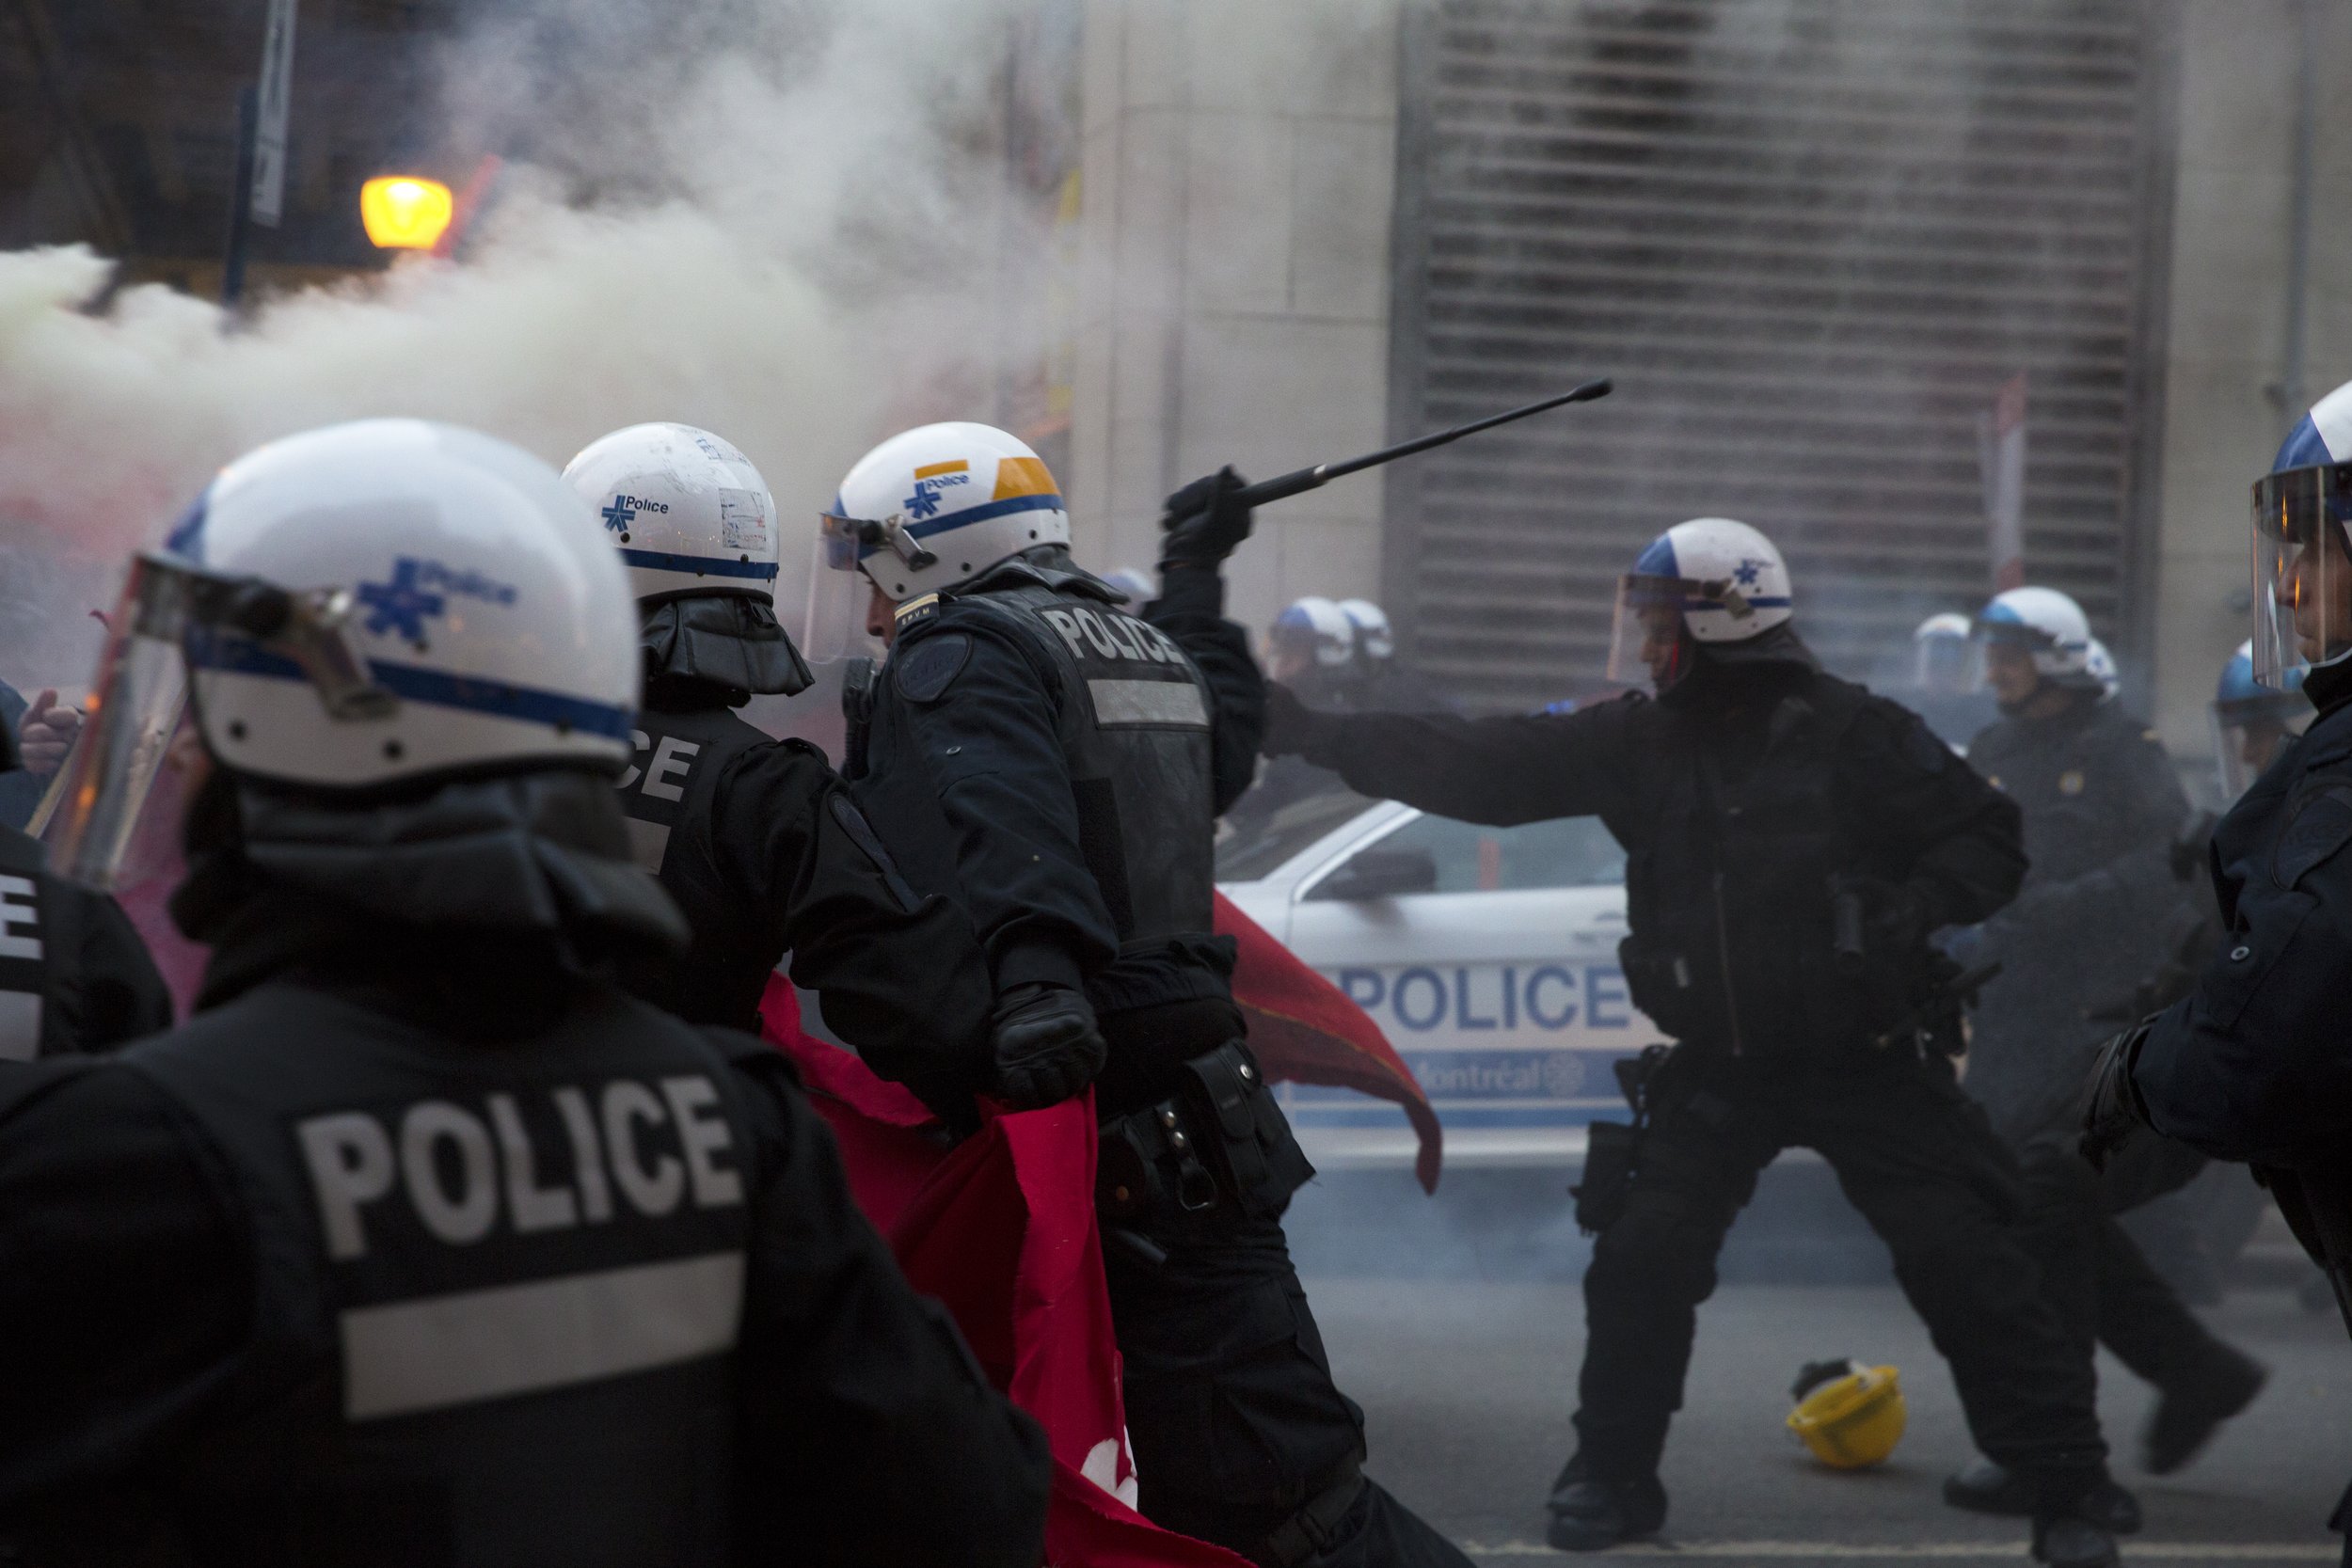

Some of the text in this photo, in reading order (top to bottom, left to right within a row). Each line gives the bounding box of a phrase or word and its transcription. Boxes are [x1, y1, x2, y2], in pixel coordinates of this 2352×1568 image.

[626, 496, 669, 515] Police
[926, 474, 970, 490] Police
[1041, 607, 1186, 664] POLICE
[1340, 965, 1630, 1031] POLICE
[298, 1075, 744, 1261] POLICE
